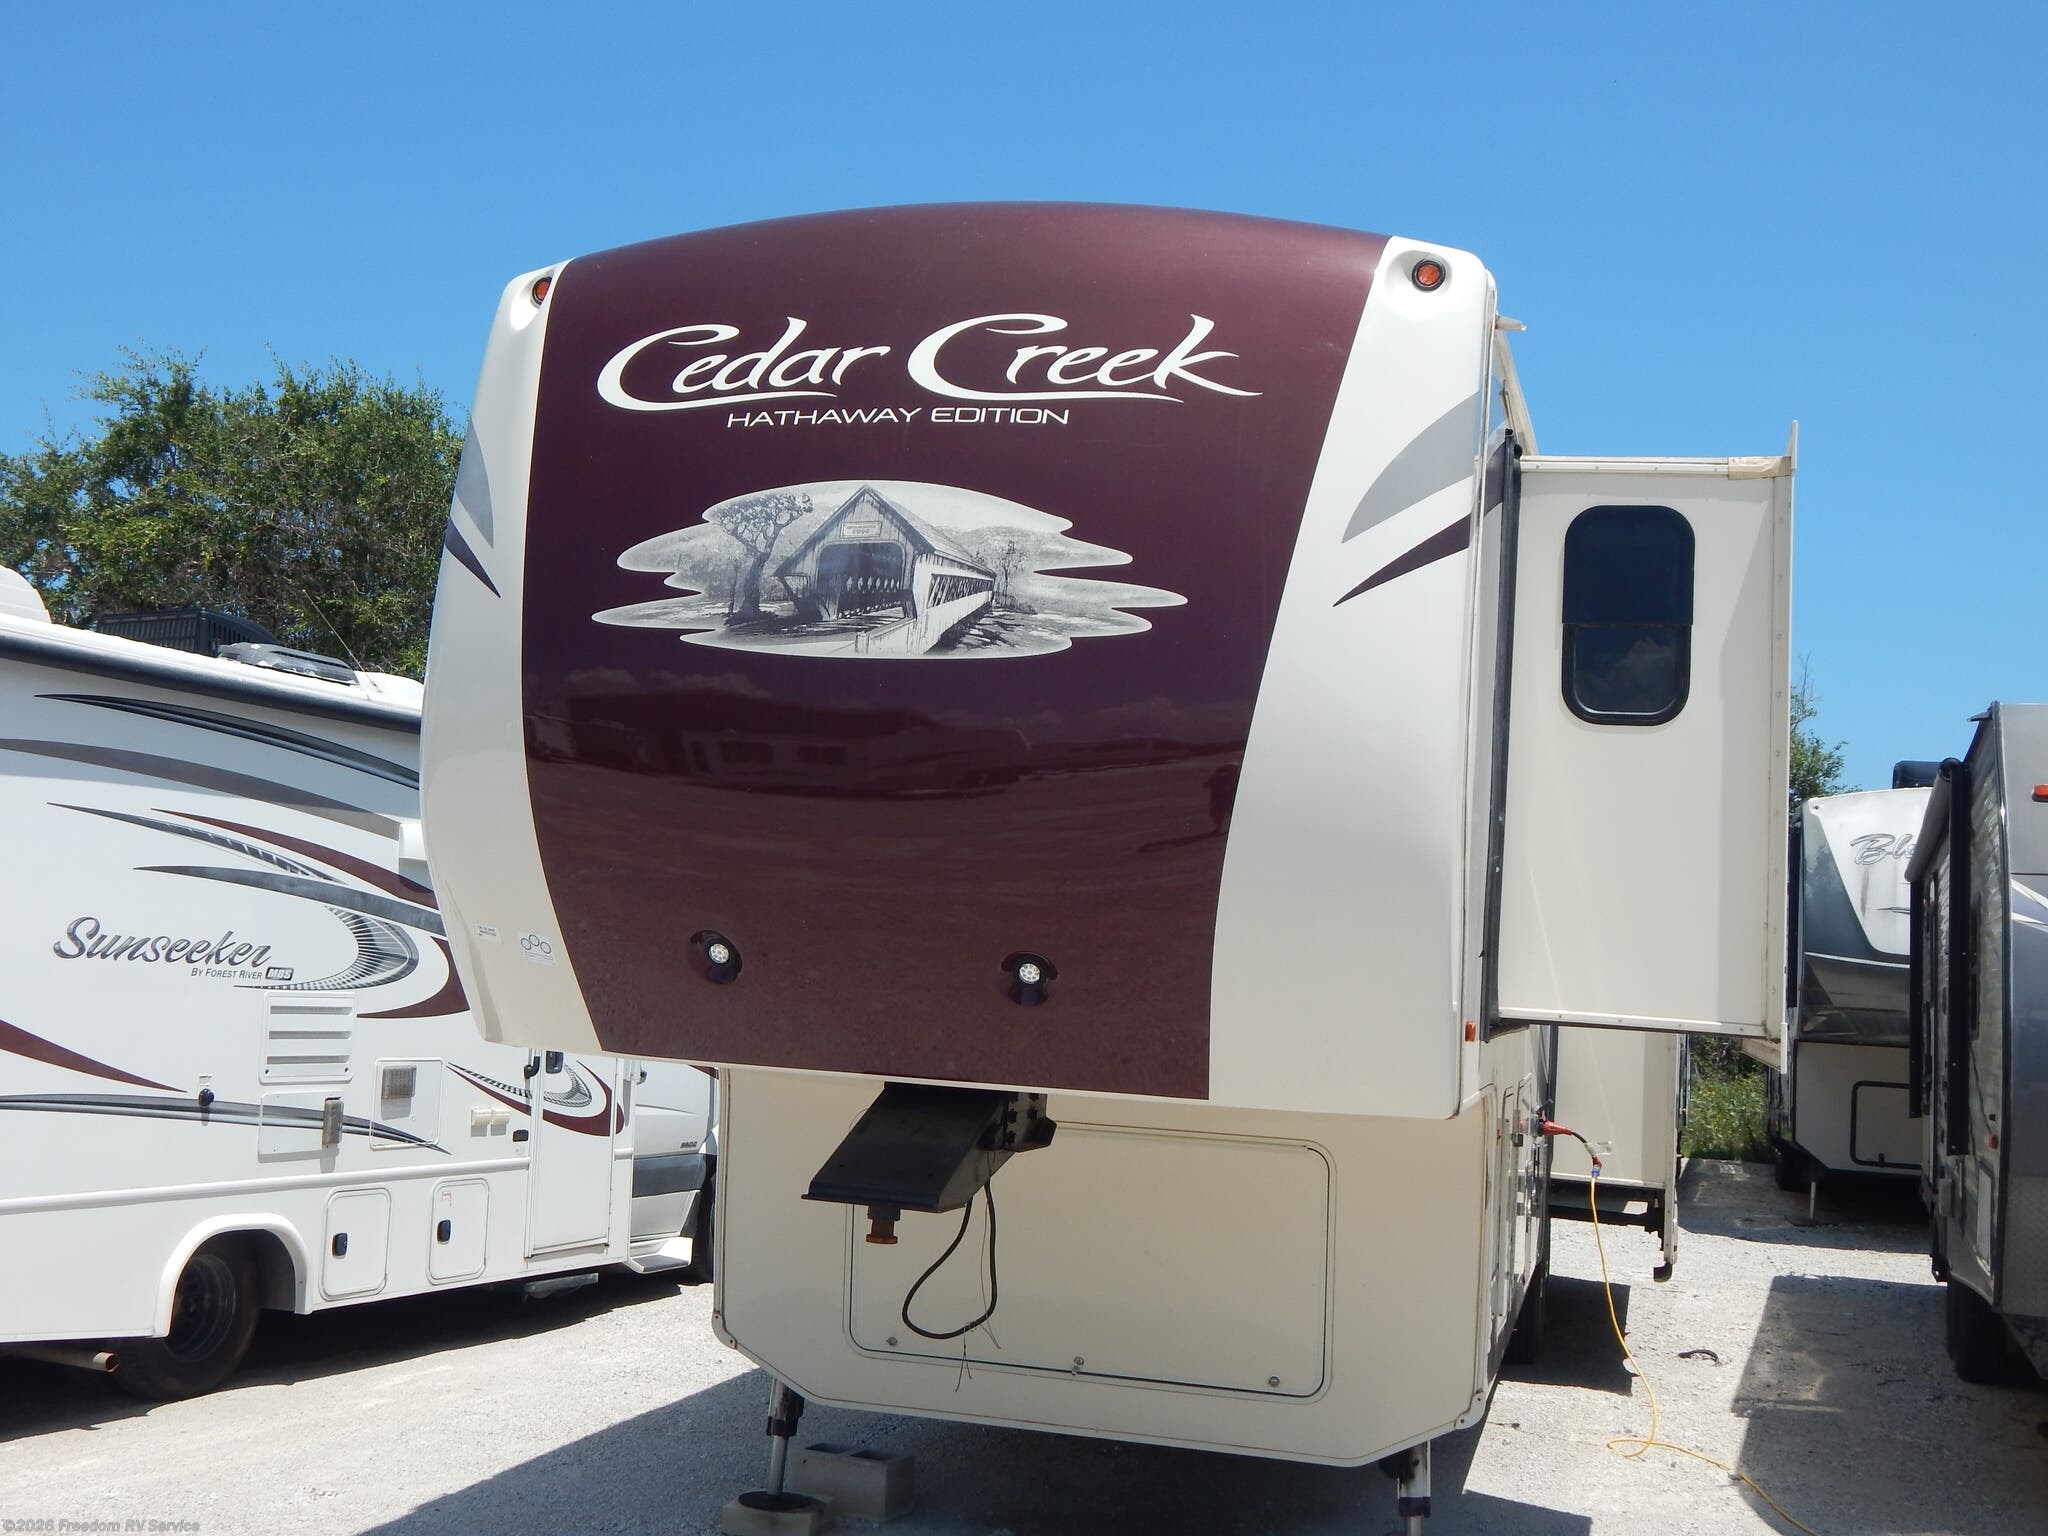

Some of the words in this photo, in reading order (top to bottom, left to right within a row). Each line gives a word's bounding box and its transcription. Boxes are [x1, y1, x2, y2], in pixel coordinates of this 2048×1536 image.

[597, 316, 890, 411] Cedar
[908, 313, 1264, 403] Creek
[727, 407, 923, 428] HATHAWAY
[930, 406, 1070, 425] EDITION
[1849, 833, 1917, 866] Bl
[53, 916, 272, 968] Sunseeker
